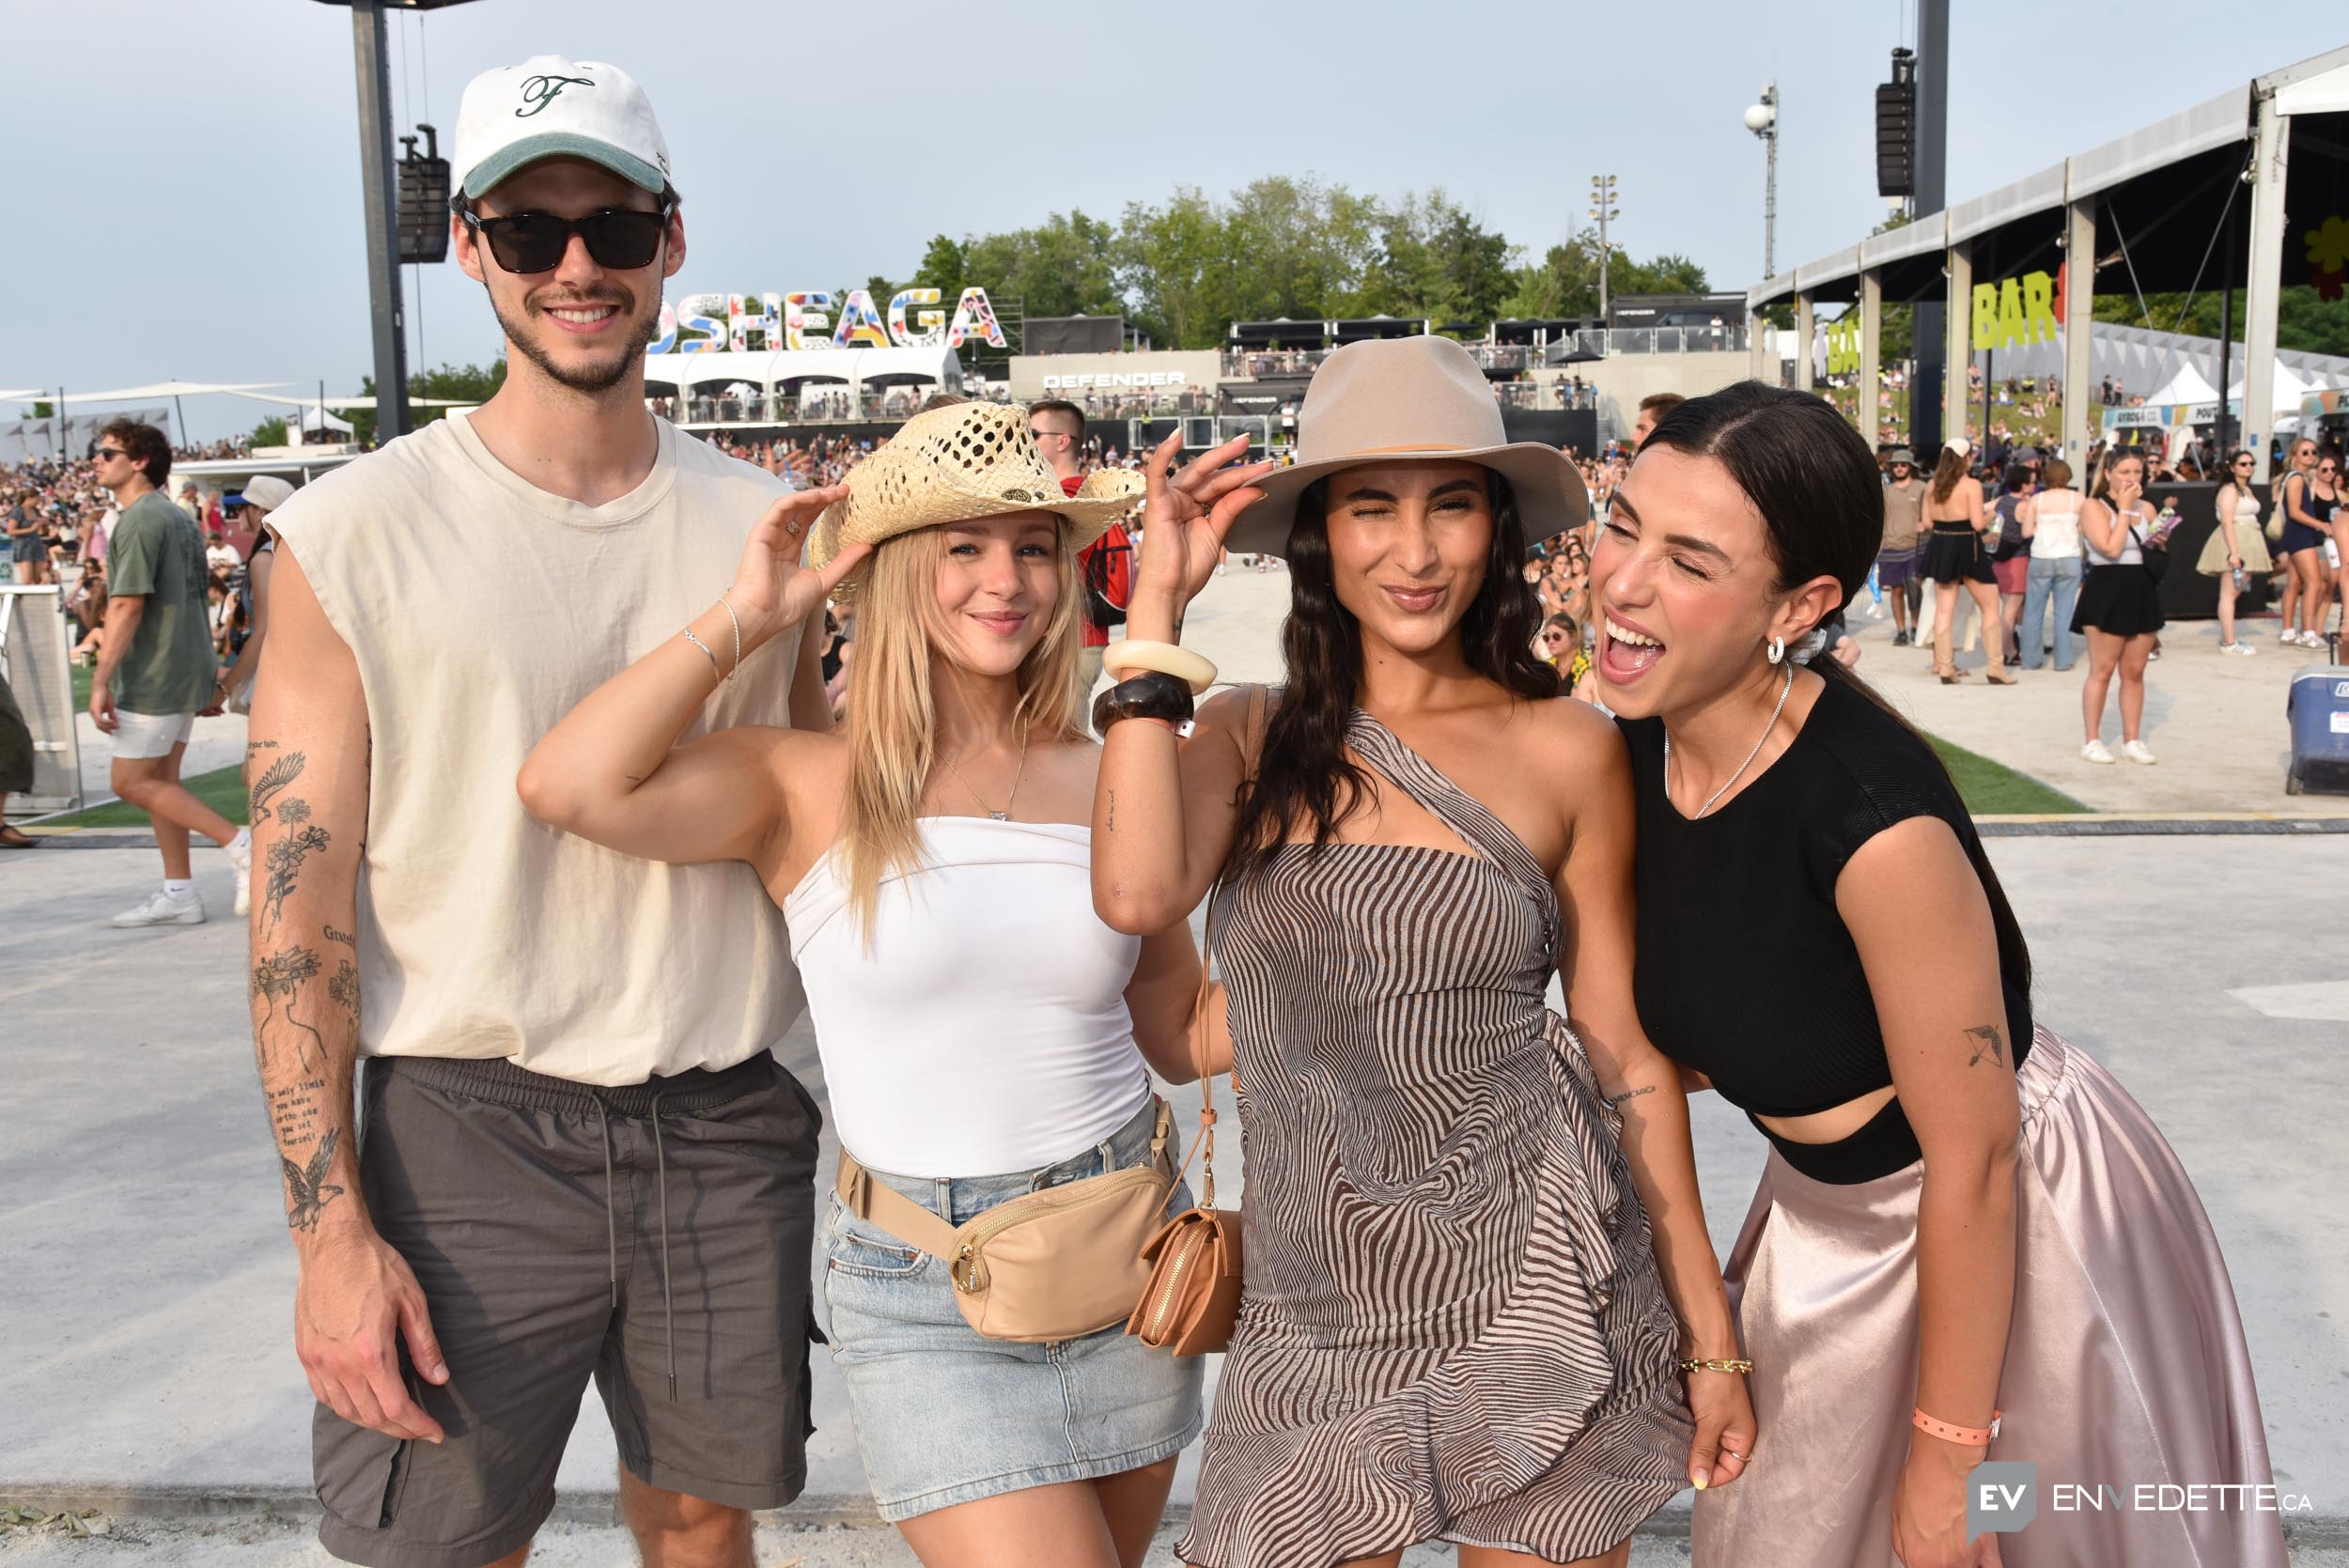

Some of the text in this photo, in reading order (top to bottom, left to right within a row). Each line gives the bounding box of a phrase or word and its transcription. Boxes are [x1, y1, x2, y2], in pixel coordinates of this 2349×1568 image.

[1973, 270, 2057, 350] BAR
[1827, 316, 1863, 375] BA
[1043, 370, 1187, 389] DEFENDER
[299, 1079, 325, 1090] limit
